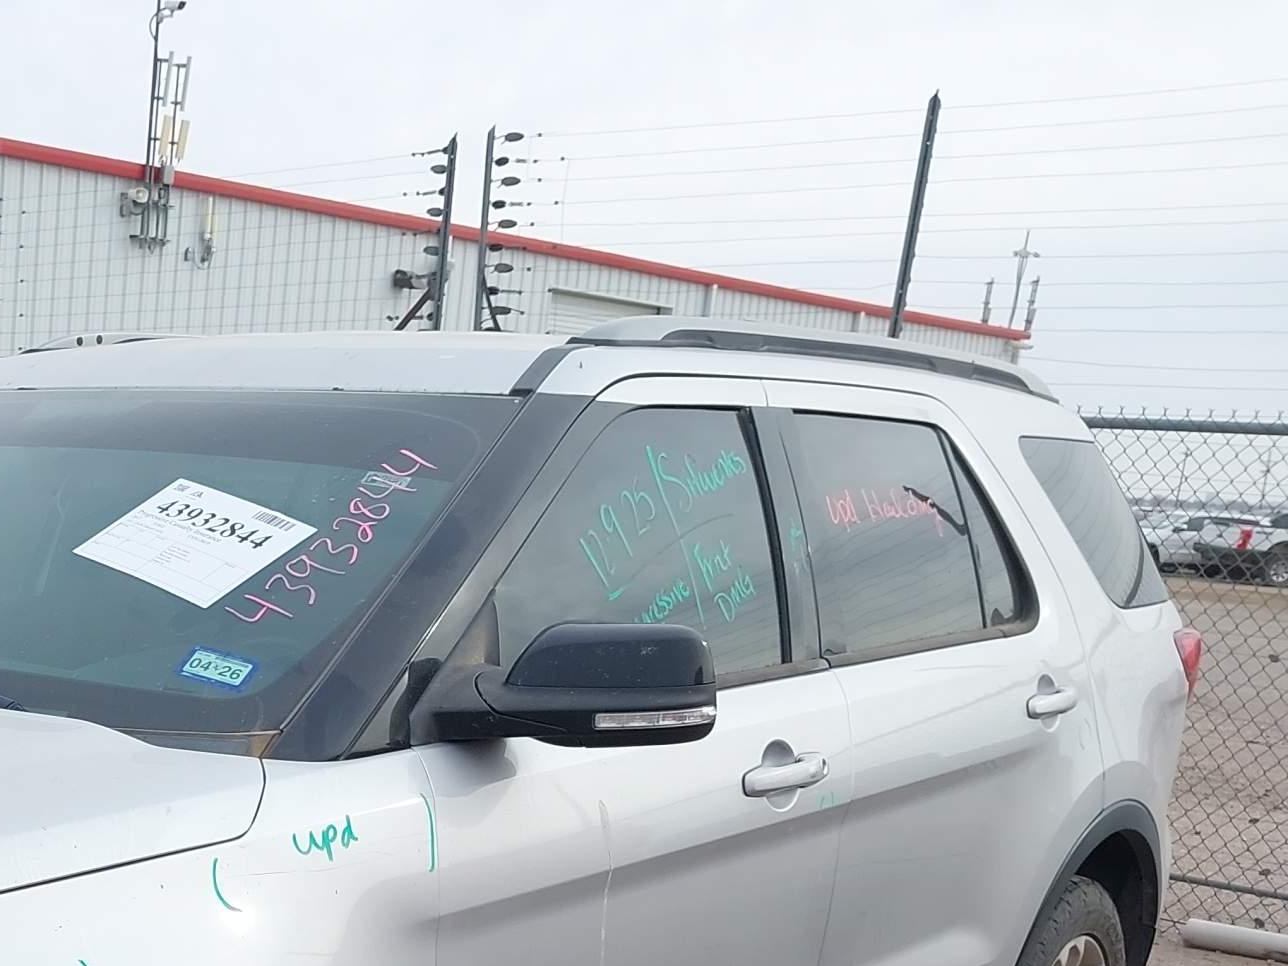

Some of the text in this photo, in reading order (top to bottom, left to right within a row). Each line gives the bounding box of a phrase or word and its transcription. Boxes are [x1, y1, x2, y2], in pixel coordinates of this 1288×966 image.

[155, 499, 275, 550] 43932844
[223, 448, 440, 623] 43932844
[217, 665, 244, 681] 26
